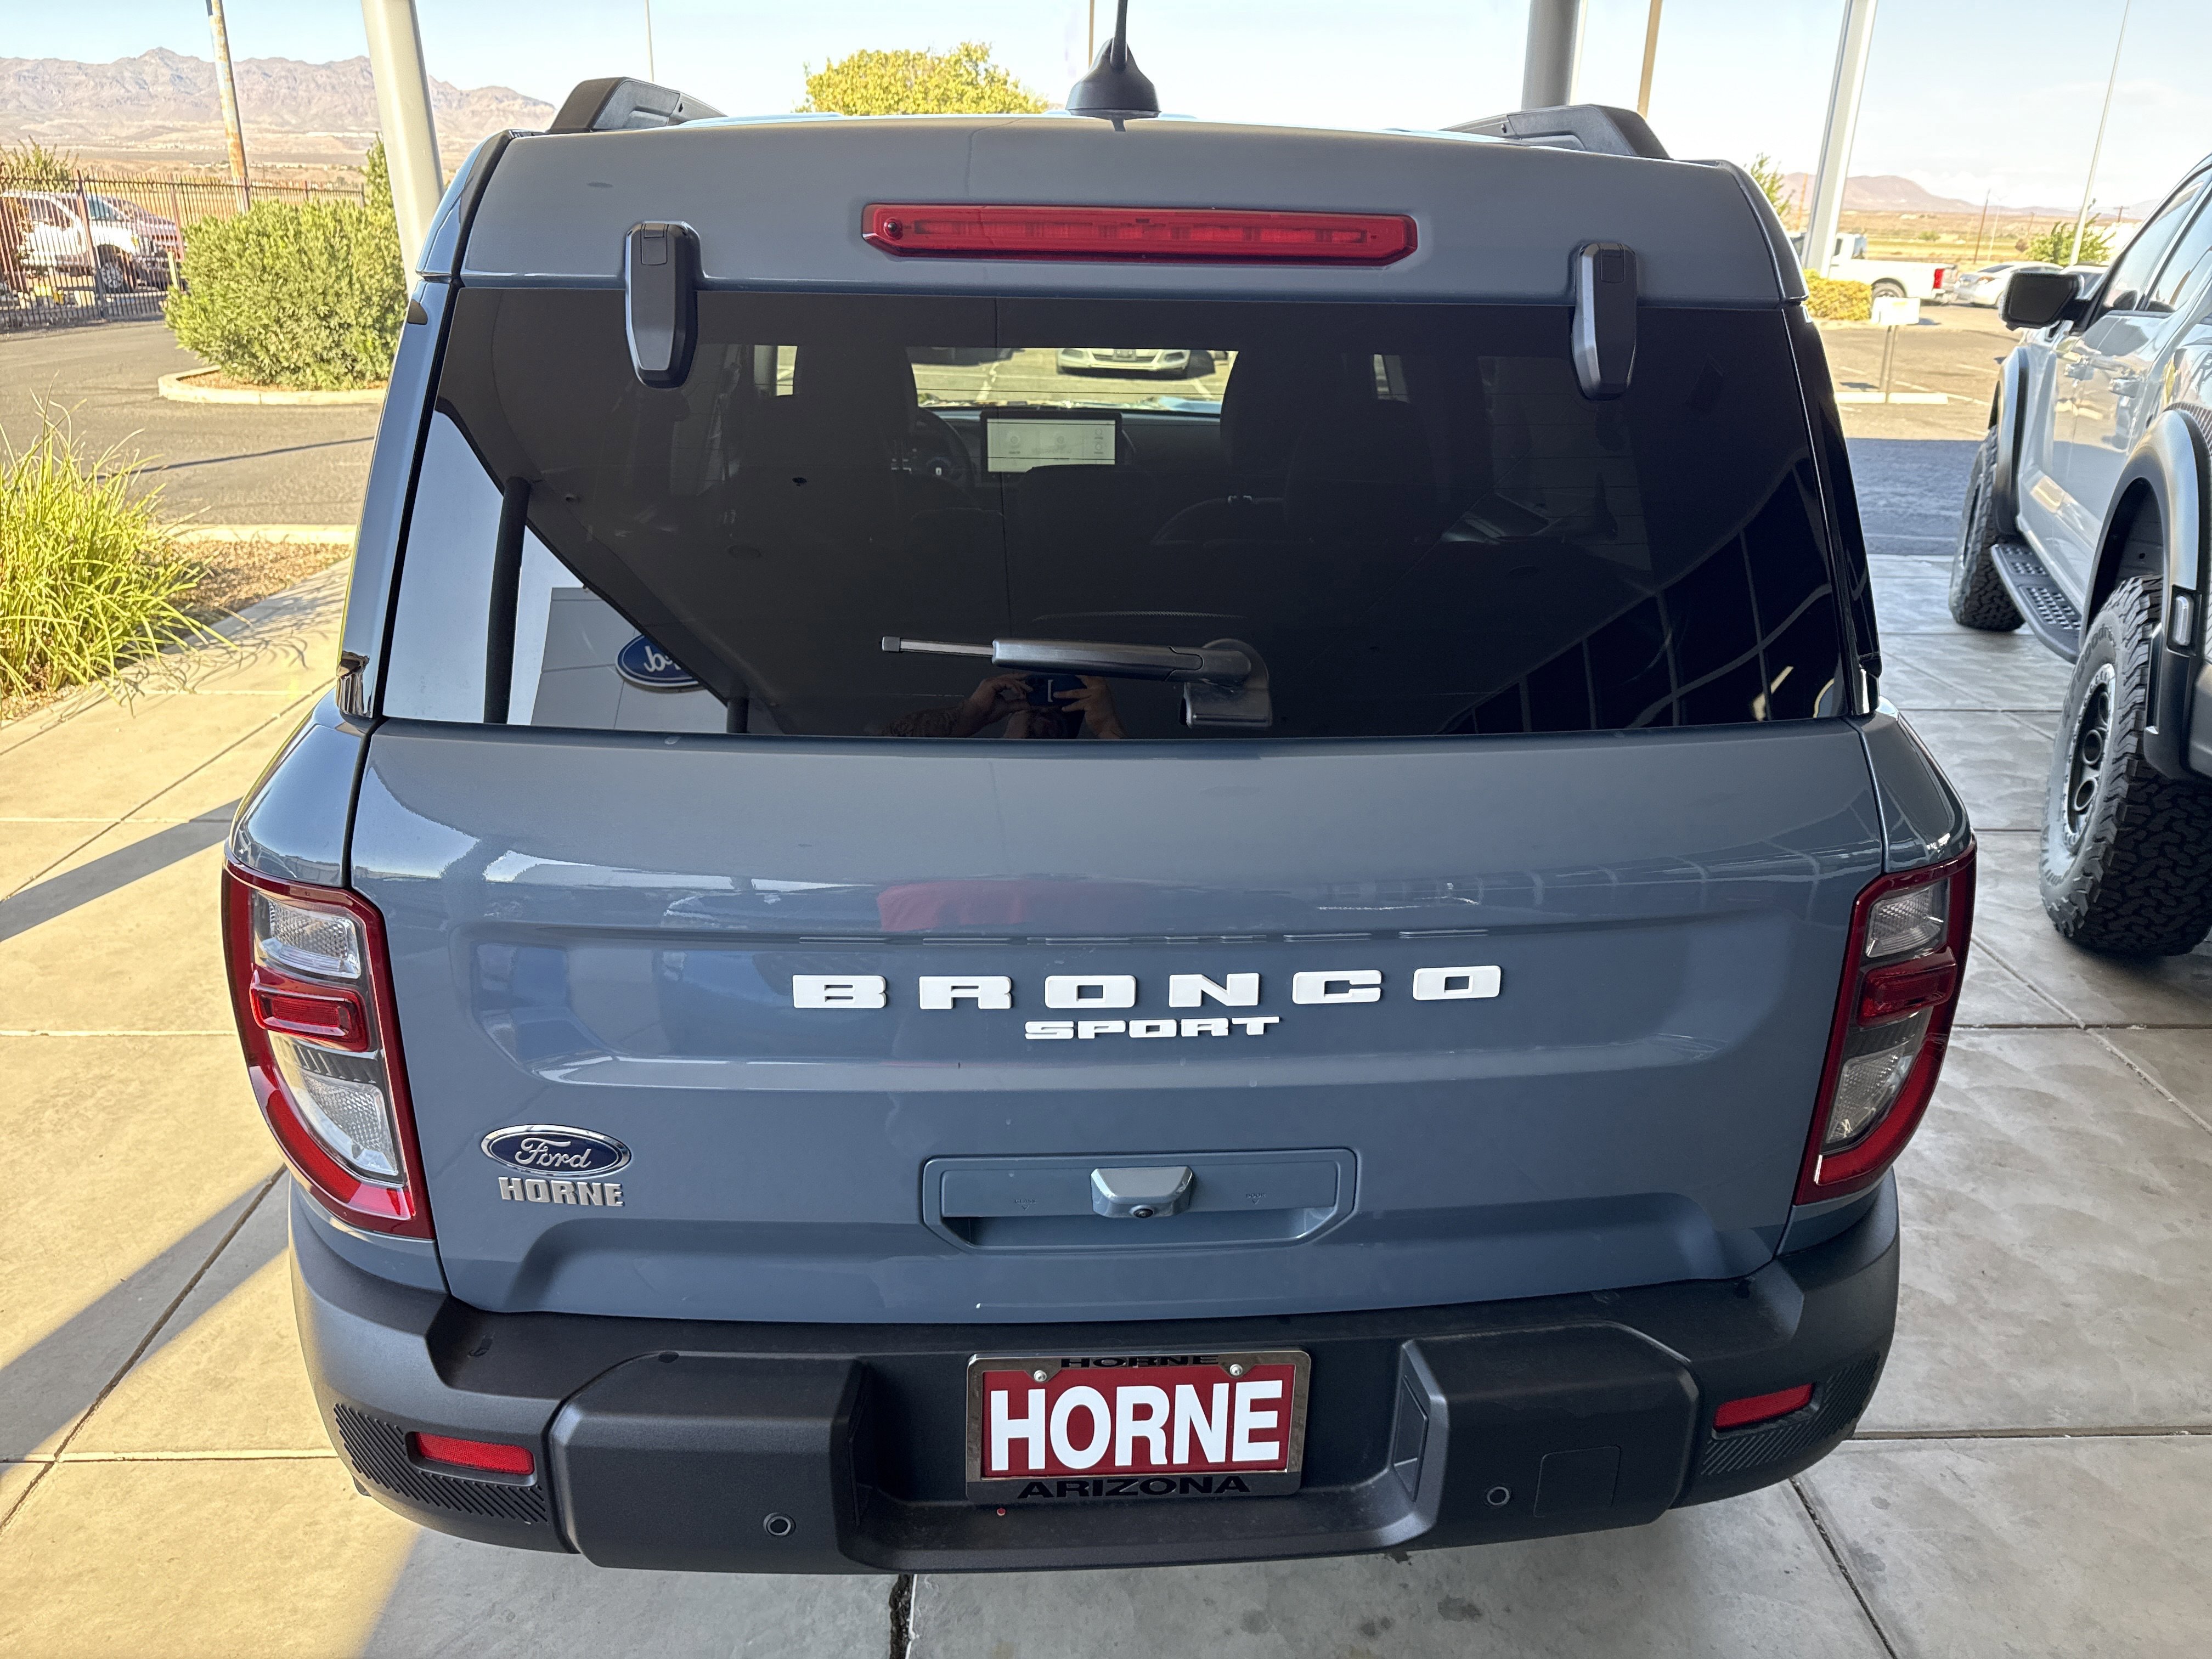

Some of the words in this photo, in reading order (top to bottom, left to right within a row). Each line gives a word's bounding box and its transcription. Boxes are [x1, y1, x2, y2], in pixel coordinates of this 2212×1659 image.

[793, 965, 1501, 1010] BRONCO
[1025, 1016, 1280, 1040] SPORT
[515, 1137, 592, 1168] Ford
[498, 1177, 624, 1207] HORNE
[1061, 1356, 1218, 1368] HORNE
[991, 1380, 1283, 1471] HORNE
[1017, 1476, 1251, 1499] ARIZONA
